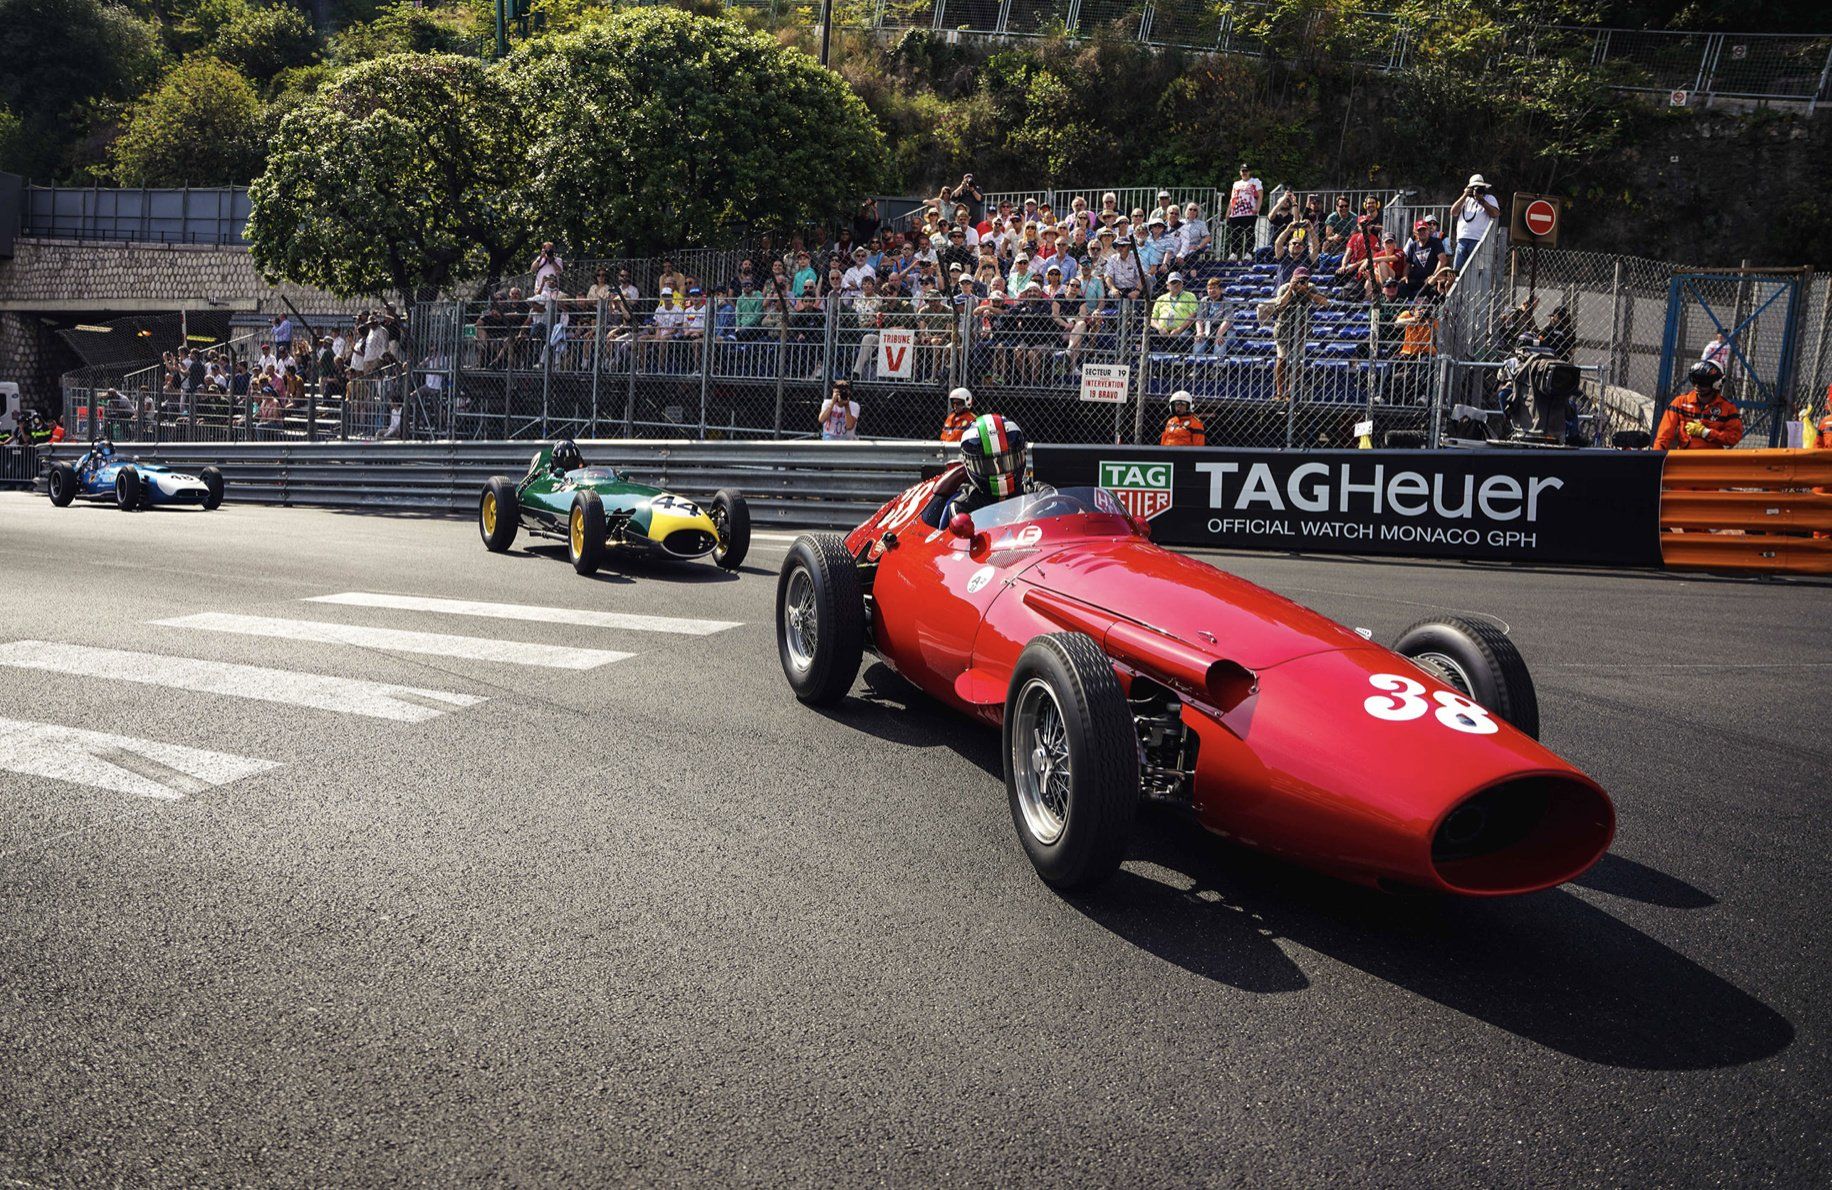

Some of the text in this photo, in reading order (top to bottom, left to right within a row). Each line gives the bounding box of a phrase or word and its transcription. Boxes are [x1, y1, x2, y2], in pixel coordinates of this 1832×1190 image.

[883, 334, 911, 344] TRIBUNE
[885, 345, 907, 372] V
[1085, 368, 1127, 377] SECTEUR 19
[1085, 380, 1124, 389] INTERVENTION
[1089, 390, 1119, 399] 19 BRAVO
[1105, 465, 1166, 487] TAG
[651, 495, 702, 517] 44
[1207, 518, 1537, 549] OFFICIAL WATCH MONACO GPH
[1363, 673, 1499, 734] 38
